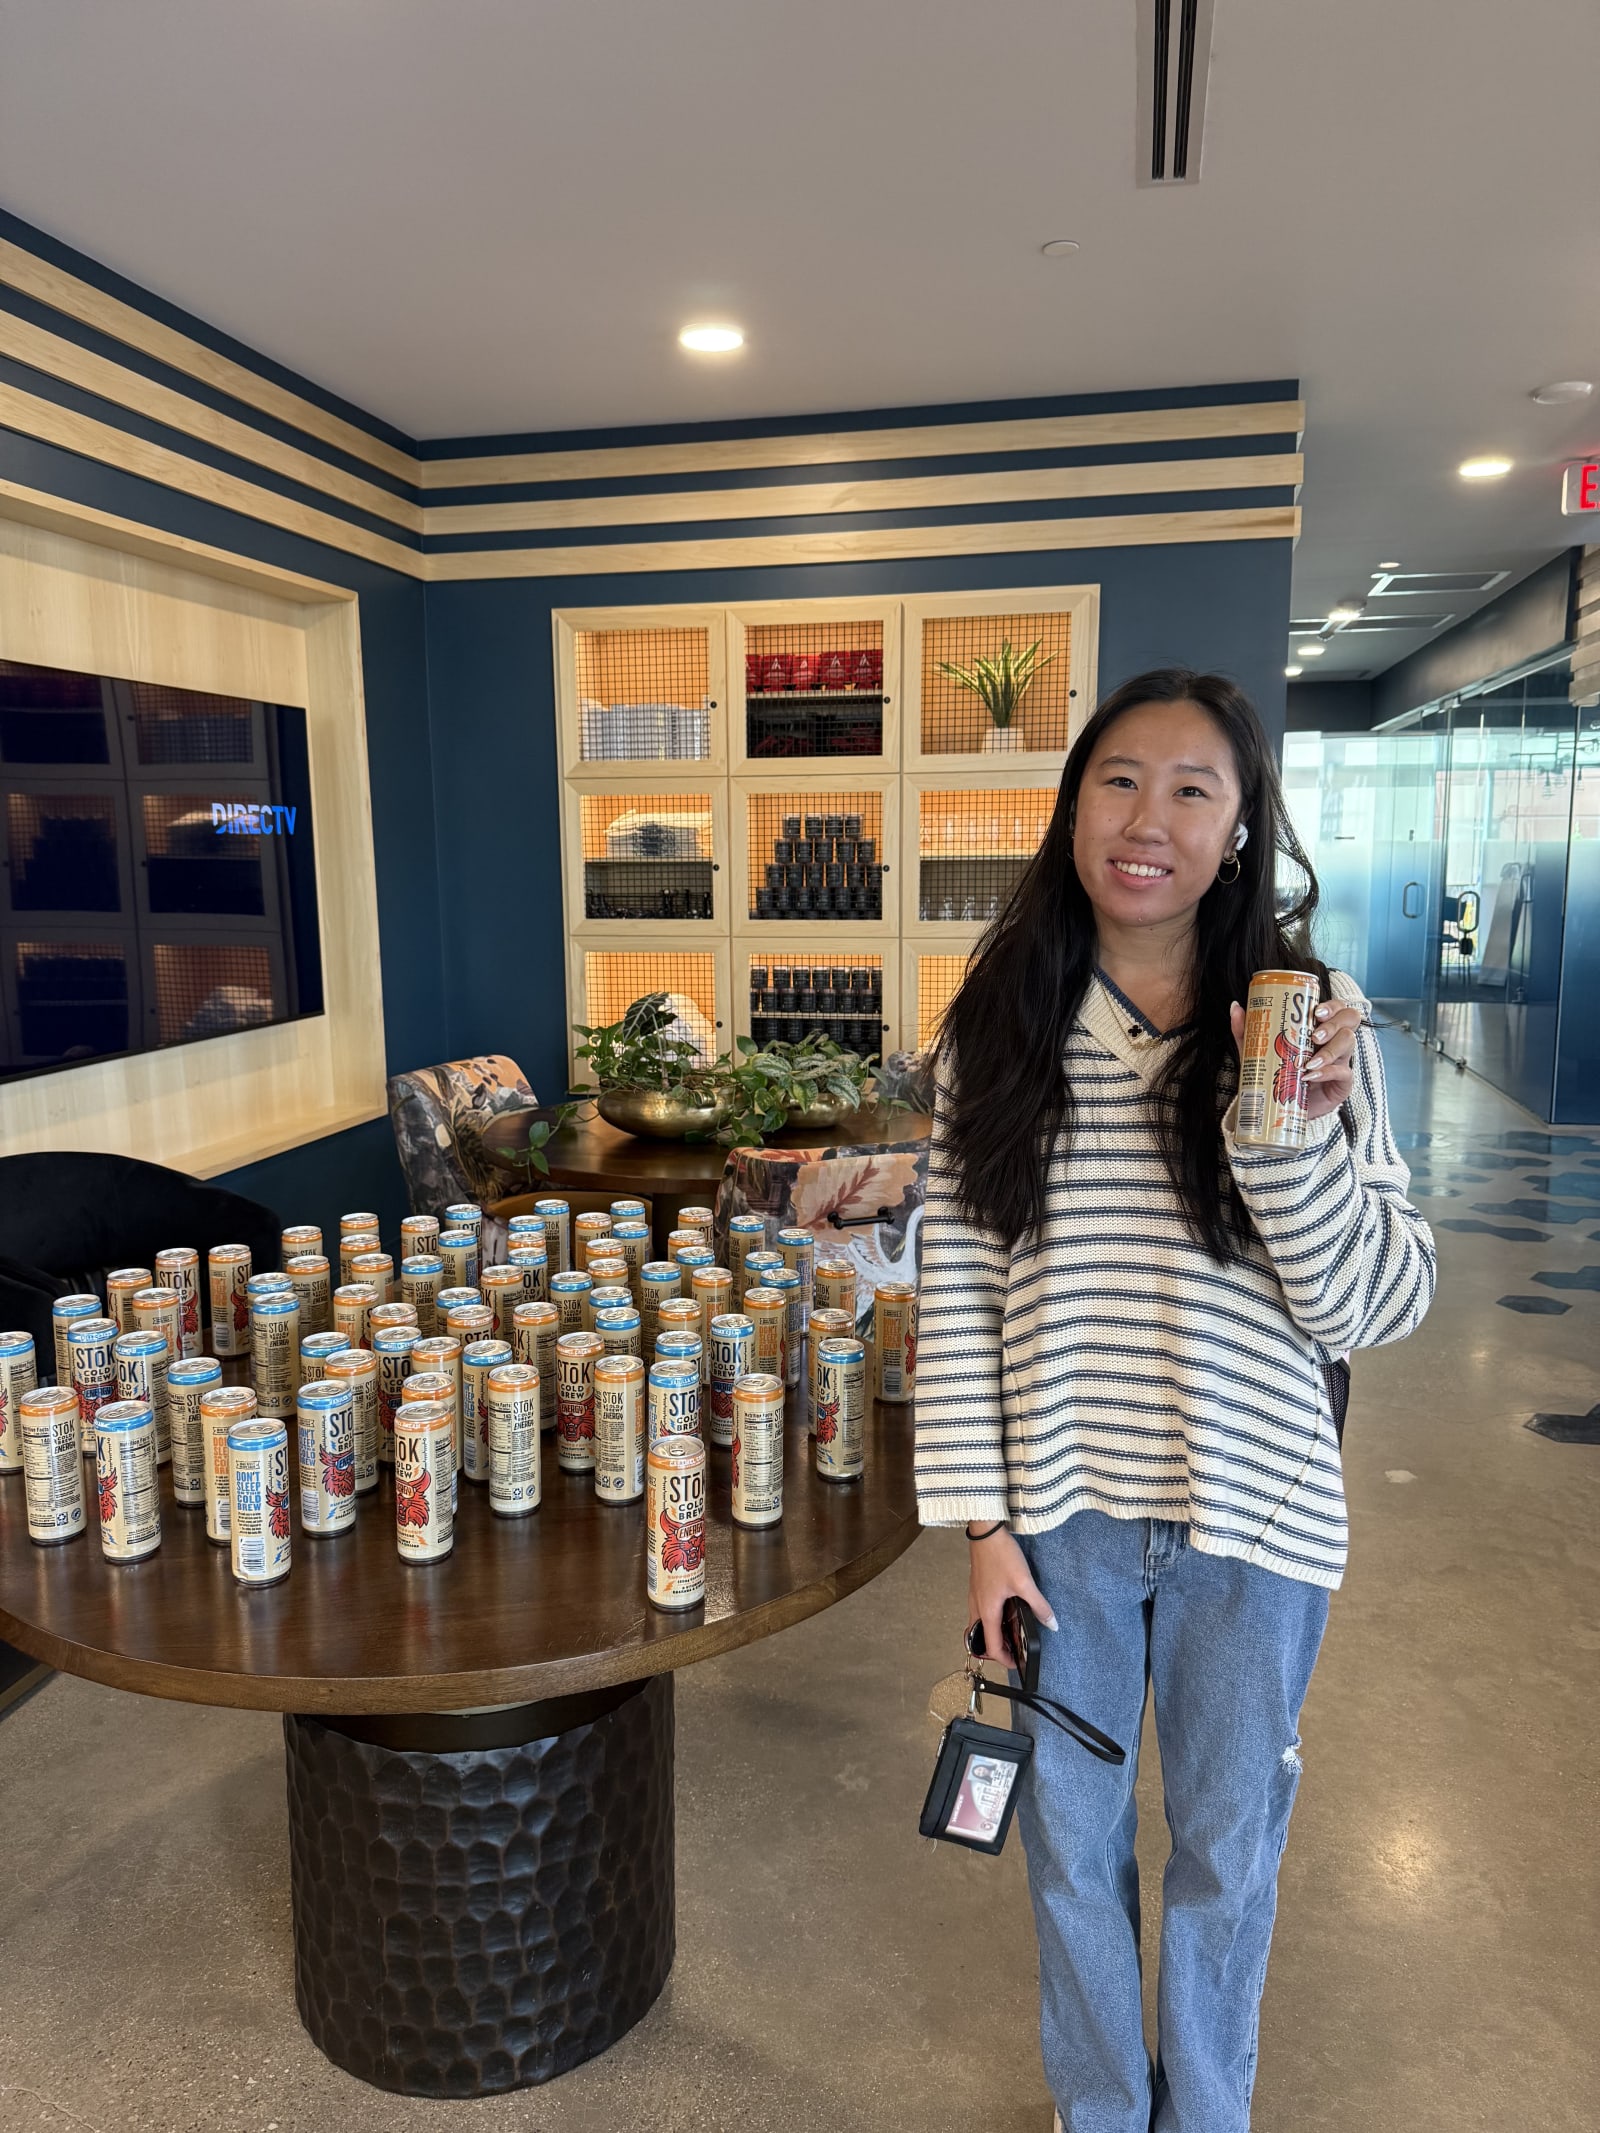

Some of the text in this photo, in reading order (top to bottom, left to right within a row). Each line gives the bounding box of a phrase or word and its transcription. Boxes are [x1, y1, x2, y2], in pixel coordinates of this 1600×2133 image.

[212, 803, 297, 835] DIRECTV
[1290, 992, 1318, 1028] ST
[417, 1234, 437, 1254] STō
[84, 1367, 111, 1377] COLD
[383, 1356, 411, 1379] STō
[713, 1369, 736, 1377] BREW
[84, 1374, 111, 1384] BREW
[561, 1384, 584, 1392] COLD
[561, 1391, 584, 1399] BREW
[562, 1404, 583, 1414] ENERGY
[603, 1412, 623, 1420] ENERGY
[677, 1412, 697, 1424] COLD
[330, 1407, 353, 1437] STō
[214, 1447, 228, 1456] SLE
[276, 1446, 288, 1476] ST
[396, 1460, 412, 1471] OLD
[236, 1471, 260, 1482] DON'T
[237, 1481, 261, 1491] SLEEP
[237, 1494, 261, 1504] COLD
[237, 1503, 261, 1511] BREW
[679, 1498, 703, 1511] COLD
[679, 1506, 703, 1520] BREW
